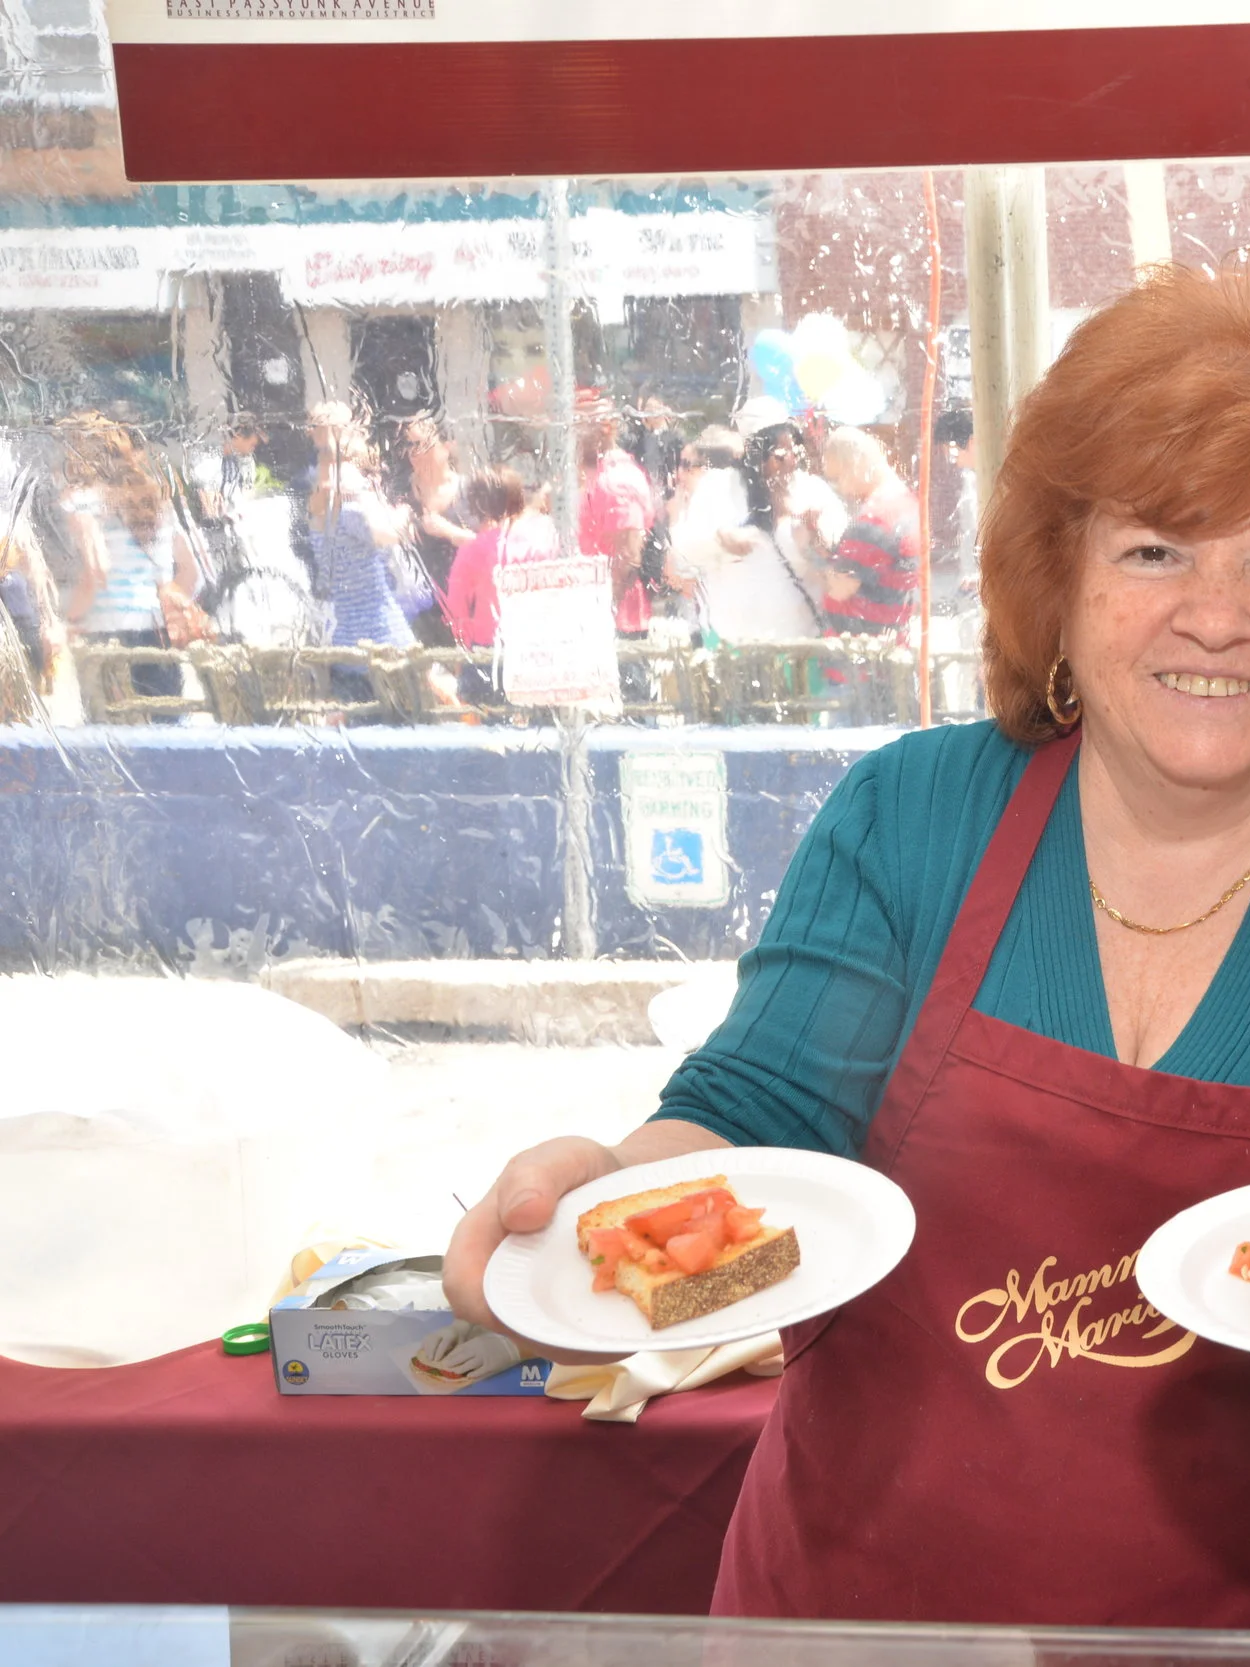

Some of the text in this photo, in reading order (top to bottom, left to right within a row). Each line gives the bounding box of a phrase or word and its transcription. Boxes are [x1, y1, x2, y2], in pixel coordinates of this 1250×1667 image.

[167, 0, 435, 8] EAST PASSYUNK AVENUE
[167, 9, 240, 17] BUSINESS
[955, 1249, 1141, 1343] Mamm
[308, 1333, 373, 1351] LATEX
[985, 1292, 1198, 1390] Mari
[521, 1365, 542, 1381] M
